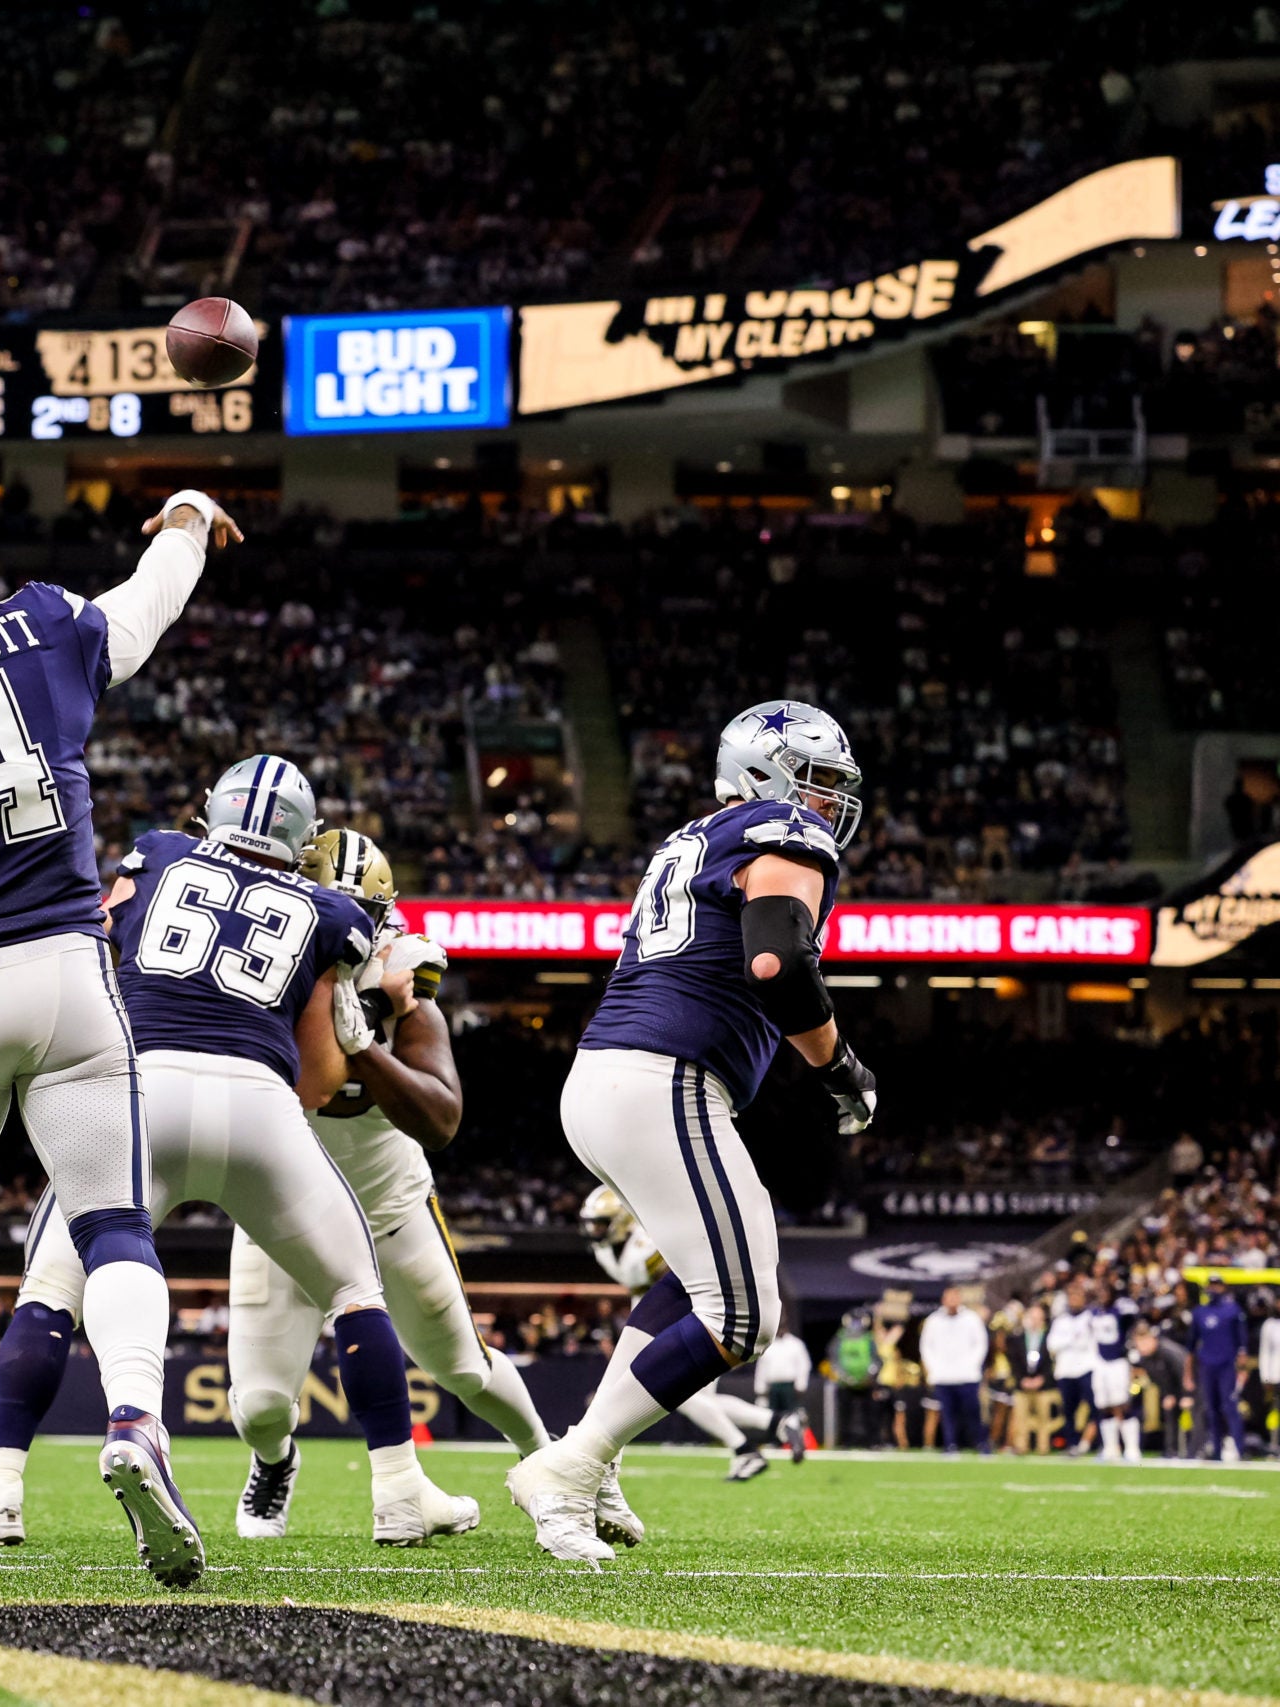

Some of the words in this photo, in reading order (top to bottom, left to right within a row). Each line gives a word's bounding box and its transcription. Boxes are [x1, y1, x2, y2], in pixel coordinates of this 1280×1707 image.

[337, 327, 456, 375] BUD
[673, 321, 733, 362] MY
[315, 366, 478, 418] LIGHT
[109, 392, 141, 438] 8
[229, 832, 272, 851] COWBOYS
[135, 857, 320, 1010] 63
[423, 911, 586, 951] RAISING
[838, 914, 1002, 953] RAISING
